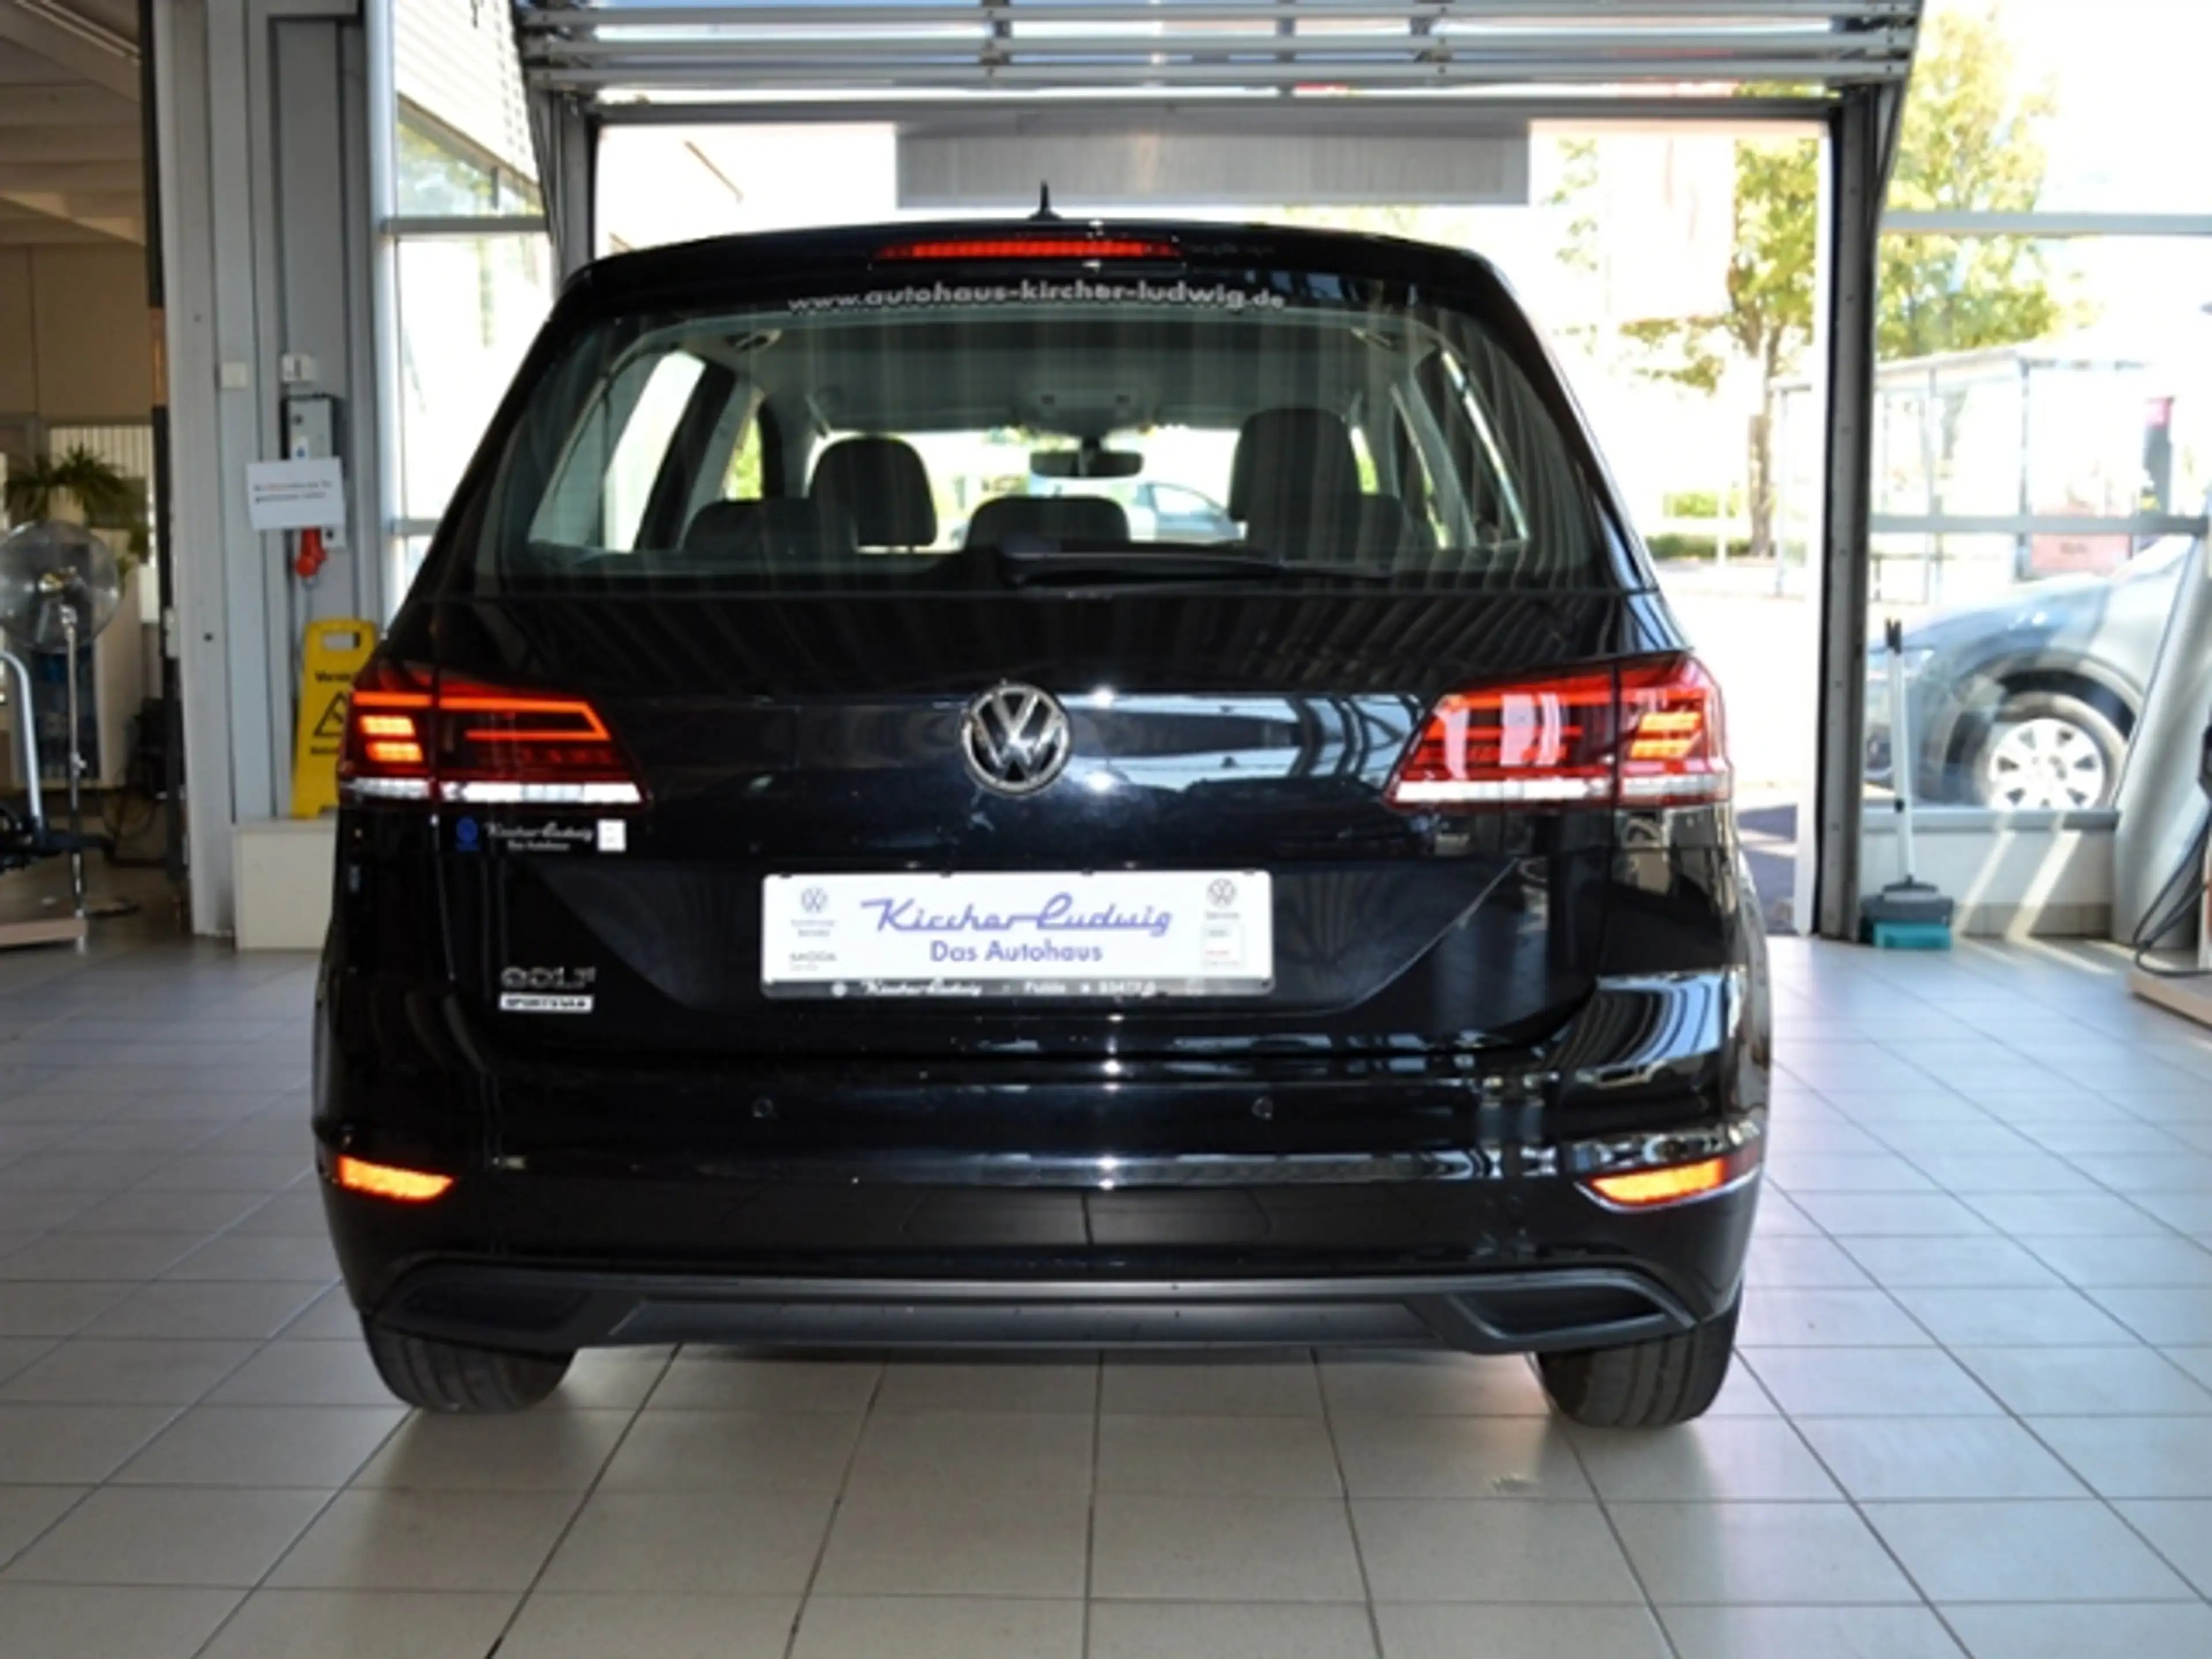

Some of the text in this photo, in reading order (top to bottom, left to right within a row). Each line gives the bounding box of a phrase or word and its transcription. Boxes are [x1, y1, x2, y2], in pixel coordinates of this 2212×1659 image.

[788, 279, 1285, 313] www.autohaus-kircher-ludwig.de
[930, 938, 1104, 962] Das Autohaus
